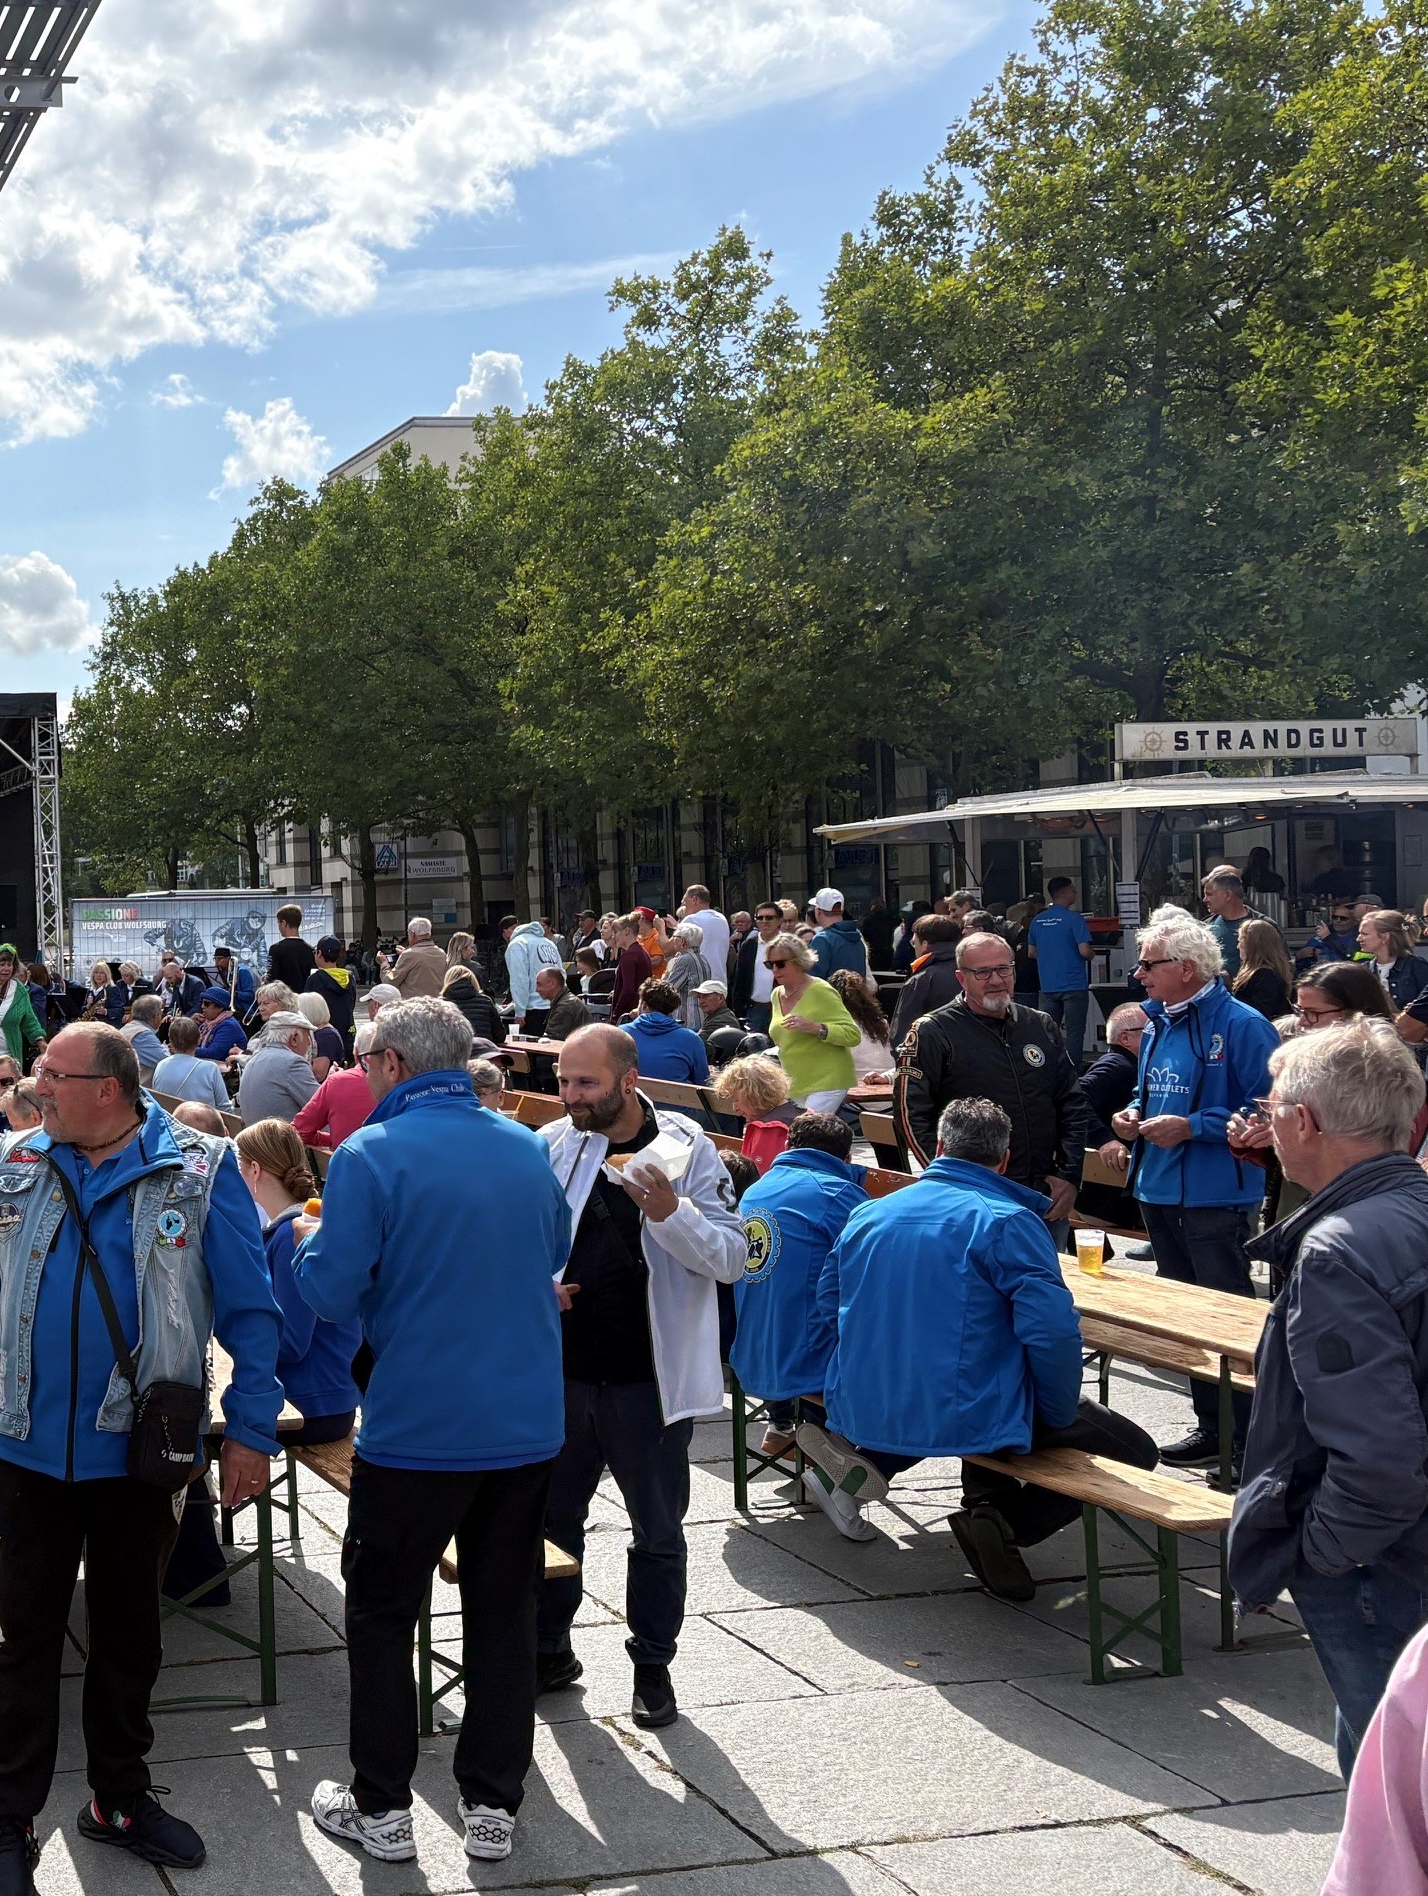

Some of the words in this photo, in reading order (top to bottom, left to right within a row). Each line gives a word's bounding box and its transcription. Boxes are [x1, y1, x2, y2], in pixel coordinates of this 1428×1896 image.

[1174, 727, 1367, 751] STRANDGUT
[412, 866, 456, 874] WOLFSBURG
[82, 908, 139, 921] PASSIONE
[82, 921, 104, 930] VESPA
[106, 921, 123, 930] CLUB
[124, 920, 167, 929] WOLFSBURG
[450, 1082, 466, 1092] Club
[1160, 1084, 1190, 1094] OUTLETS
